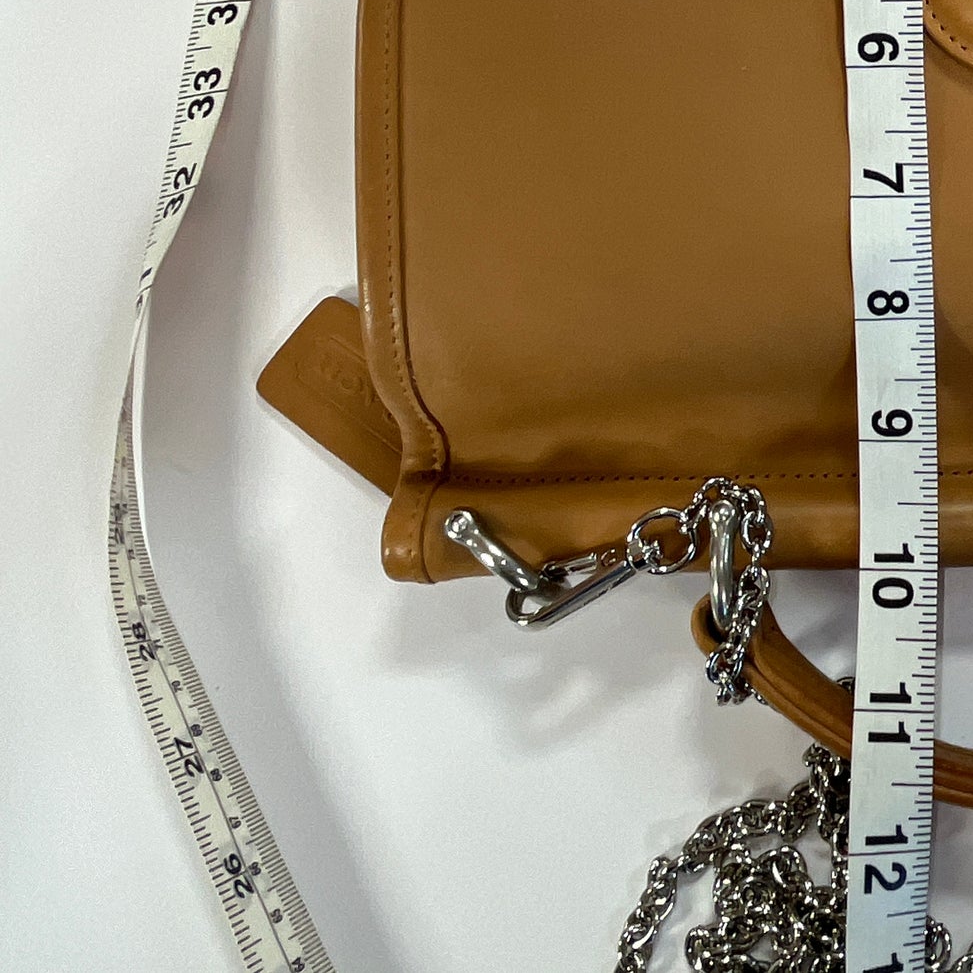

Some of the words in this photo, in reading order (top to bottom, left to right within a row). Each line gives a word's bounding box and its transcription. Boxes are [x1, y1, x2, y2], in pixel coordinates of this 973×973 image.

[858, 32, 899, 63] 6
[187, 67, 223, 121] 33
[163, 162, 198, 218] 32
[863, 162, 904, 194] 7
[867, 290, 910, 317] 8
[871, 409, 913, 437] 9
[872, 543, 915, 609] 10
[868, 682, 912, 744] 11
[173, 737, 204, 778] 27
[227, 815, 242, 830] 67
[224, 853, 255, 899] 26
[864, 824, 909, 895] 12
